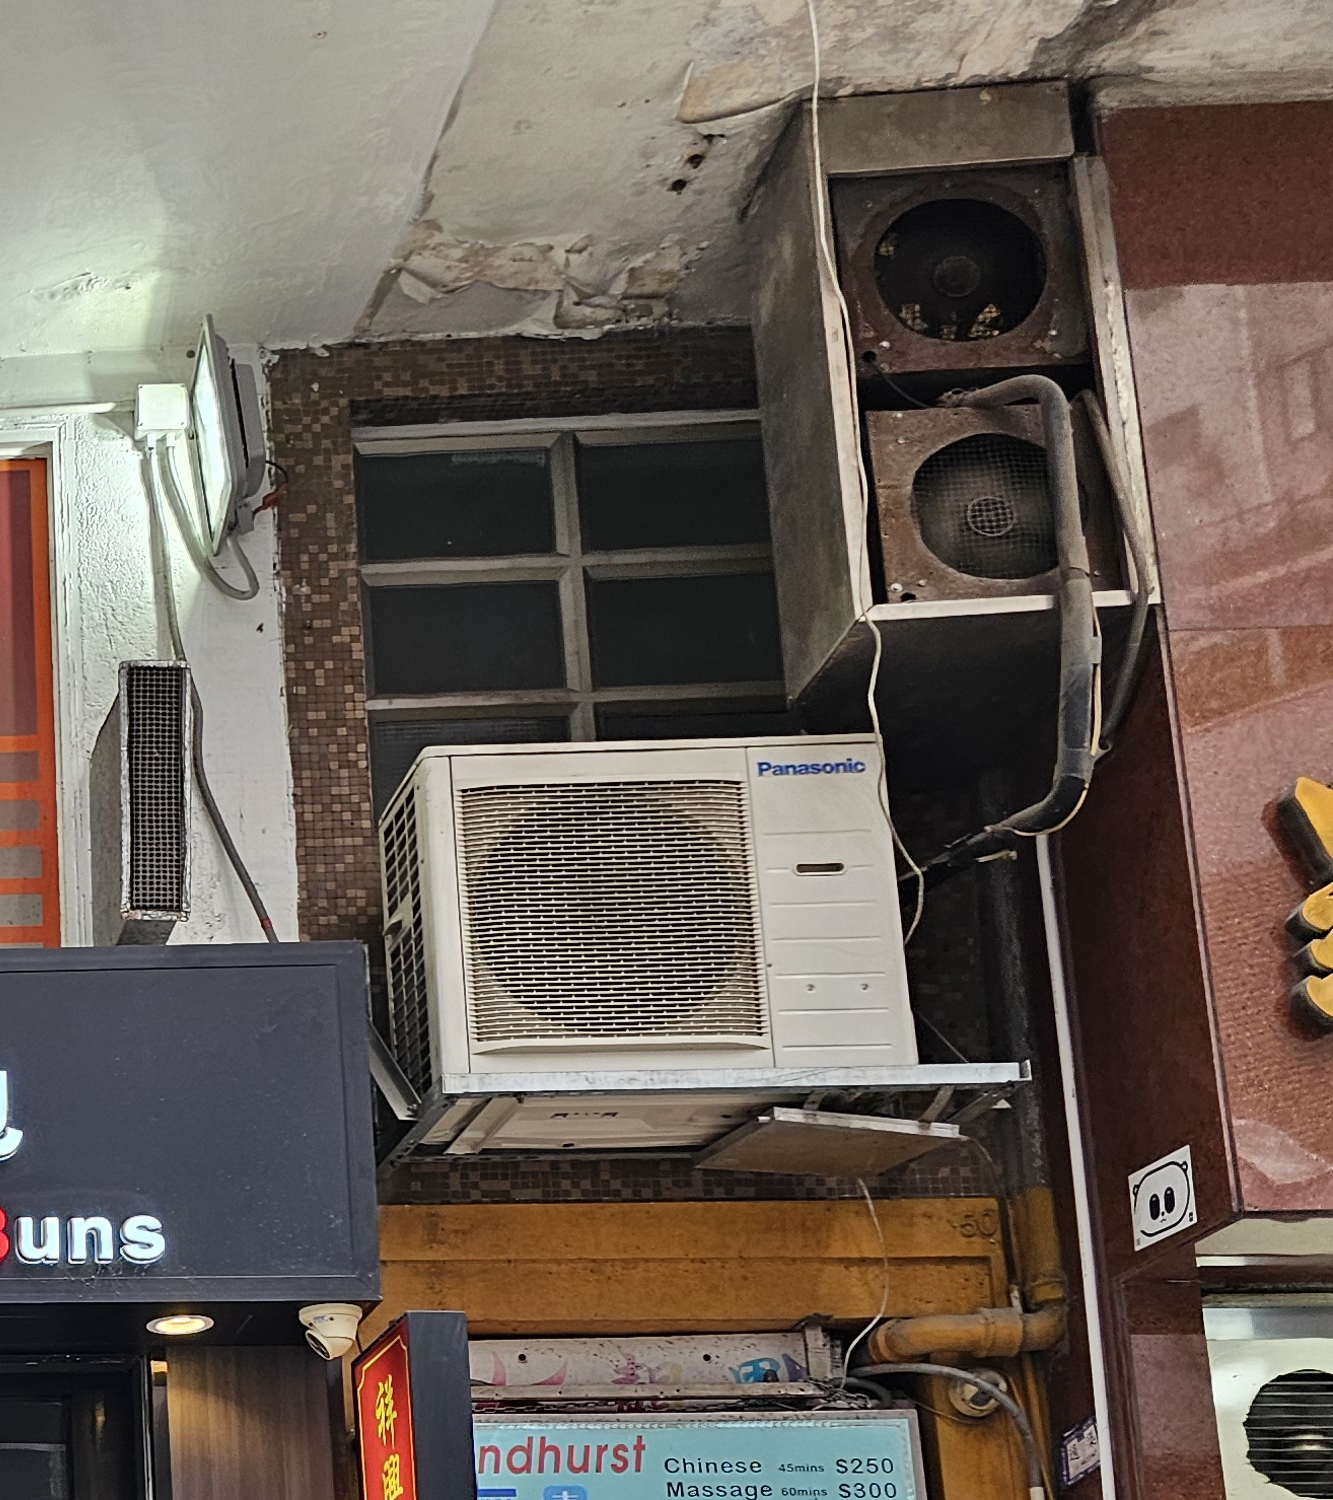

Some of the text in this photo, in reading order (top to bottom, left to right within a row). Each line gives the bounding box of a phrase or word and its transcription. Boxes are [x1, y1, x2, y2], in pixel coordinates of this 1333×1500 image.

[757, 758, 866, 776] Panasonic
[477, 1435, 647, 1475] ndhurst
[664, 1457, 894, 1475] Chinese 45mins $250
[666, 1481, 897, 1500] Massage 60mins $300
